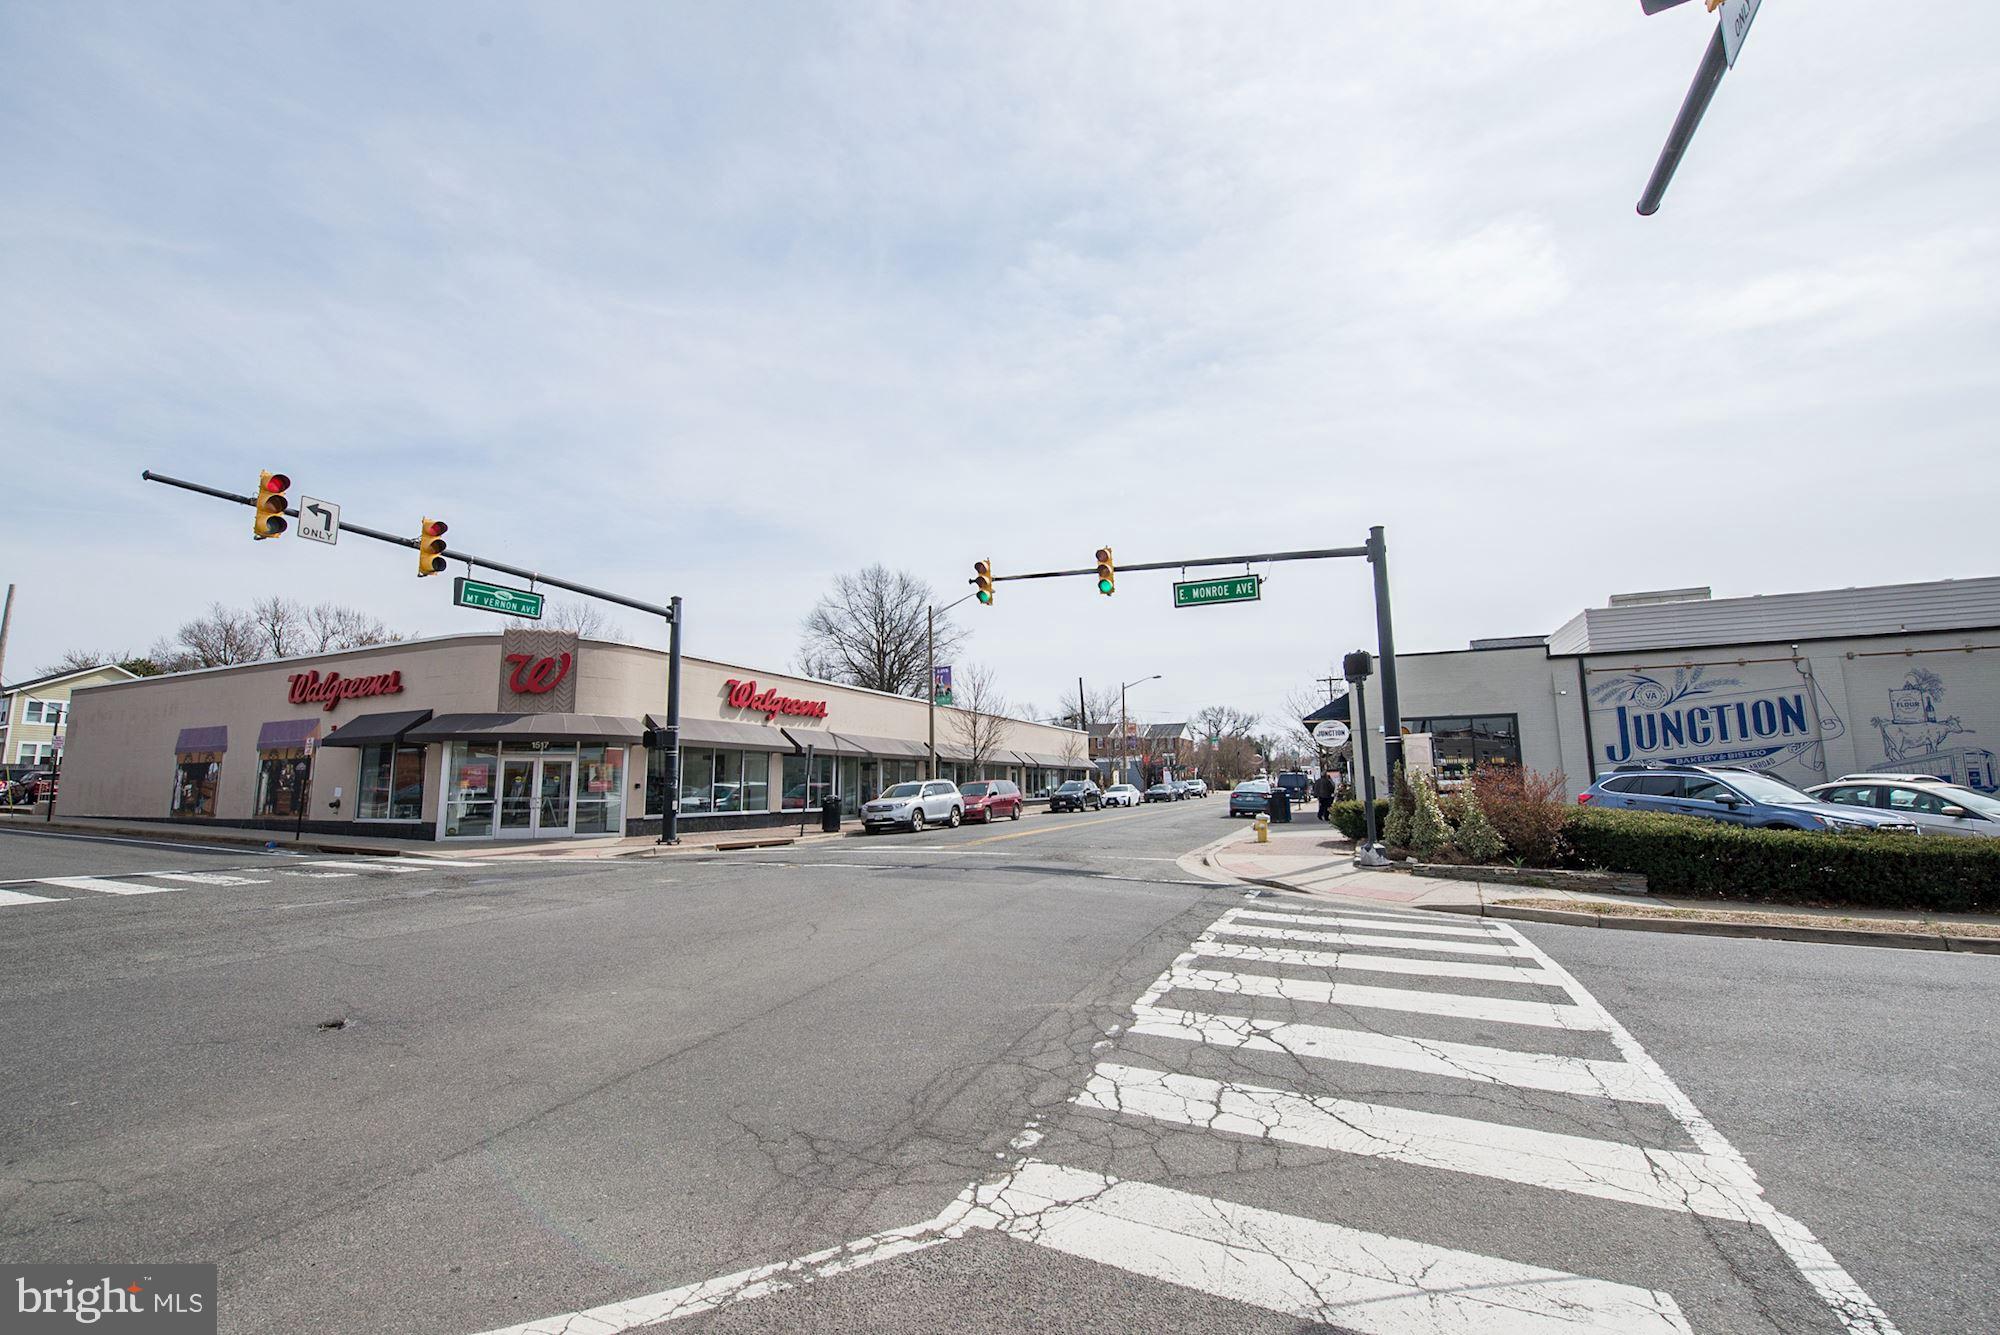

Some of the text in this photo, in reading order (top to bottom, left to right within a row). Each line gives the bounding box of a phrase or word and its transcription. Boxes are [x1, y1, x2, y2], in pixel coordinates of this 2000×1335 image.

[303, 527, 332, 540] ONLY
[1179, 583, 1253, 599] E. MONROE AVE
[466, 594, 536, 614] MT VERNON AVE
[505, 653, 571, 694] W
[288, 670, 404, 712] Walgreens
[726, 679, 828, 720] Walgreens
[1317, 729, 1346, 737] JUNCTION
[1605, 694, 1809, 763] JUNCTION
[531, 741, 549, 749] 1517
